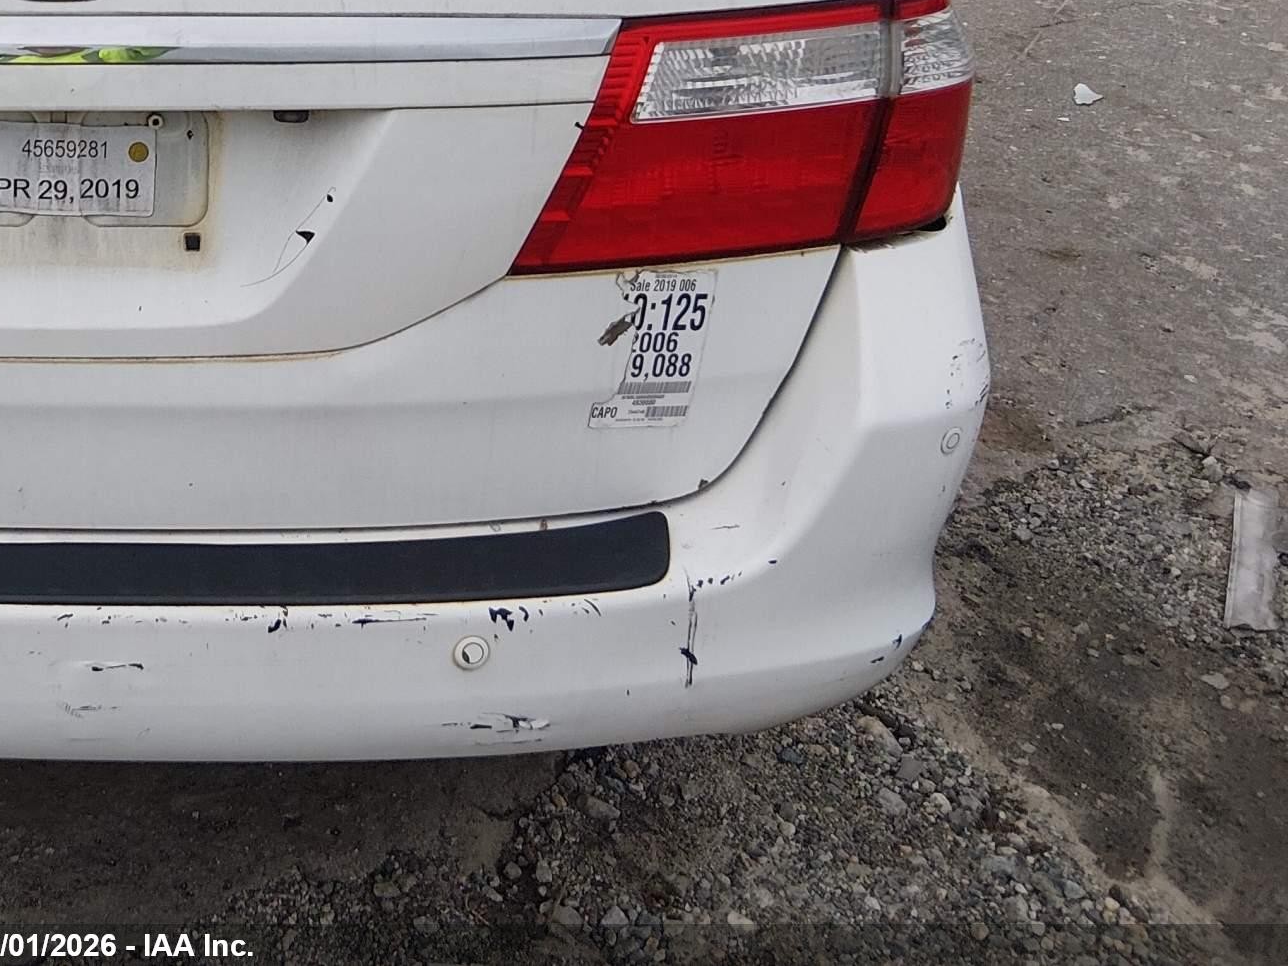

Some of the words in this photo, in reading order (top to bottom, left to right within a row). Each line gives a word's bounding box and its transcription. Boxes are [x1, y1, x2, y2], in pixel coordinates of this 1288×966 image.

[21, 138, 109, 159] 45659281
[38, 179, 75, 203] 29,
[79, 178, 140, 200] 2019
[630, 279, 651, 292] Sale
[653, 278, 677, 292] 2019
[679, 278, 697, 292] 006
[630, 353, 692, 382] 9,088
[591, 406, 618, 419] CAPO
